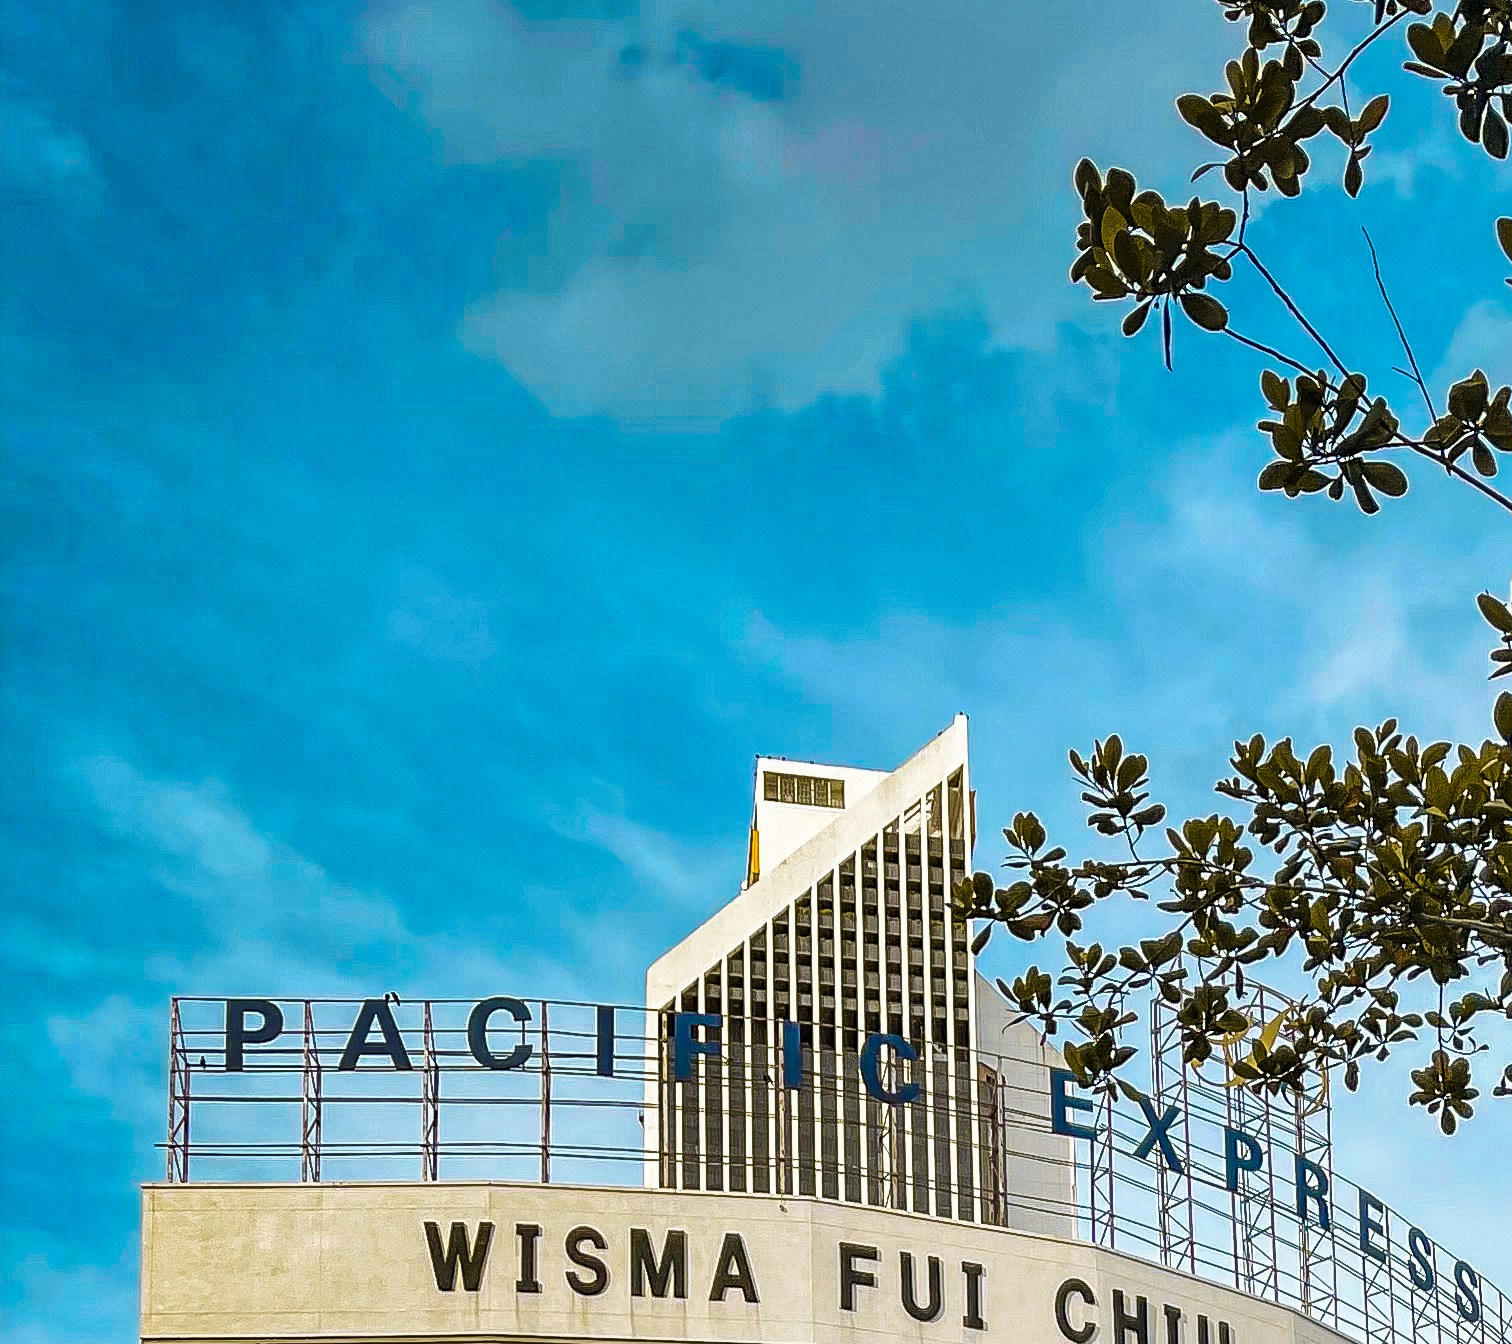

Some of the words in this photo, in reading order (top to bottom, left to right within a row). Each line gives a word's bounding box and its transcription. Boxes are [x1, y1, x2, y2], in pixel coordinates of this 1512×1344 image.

[224, 998, 922, 1104] PACIFIC
[1051, 1068, 1482, 1323] EXPRESS
[423, 1220, 760, 1304] WISMA
[839, 1241, 988, 1331] FUI
